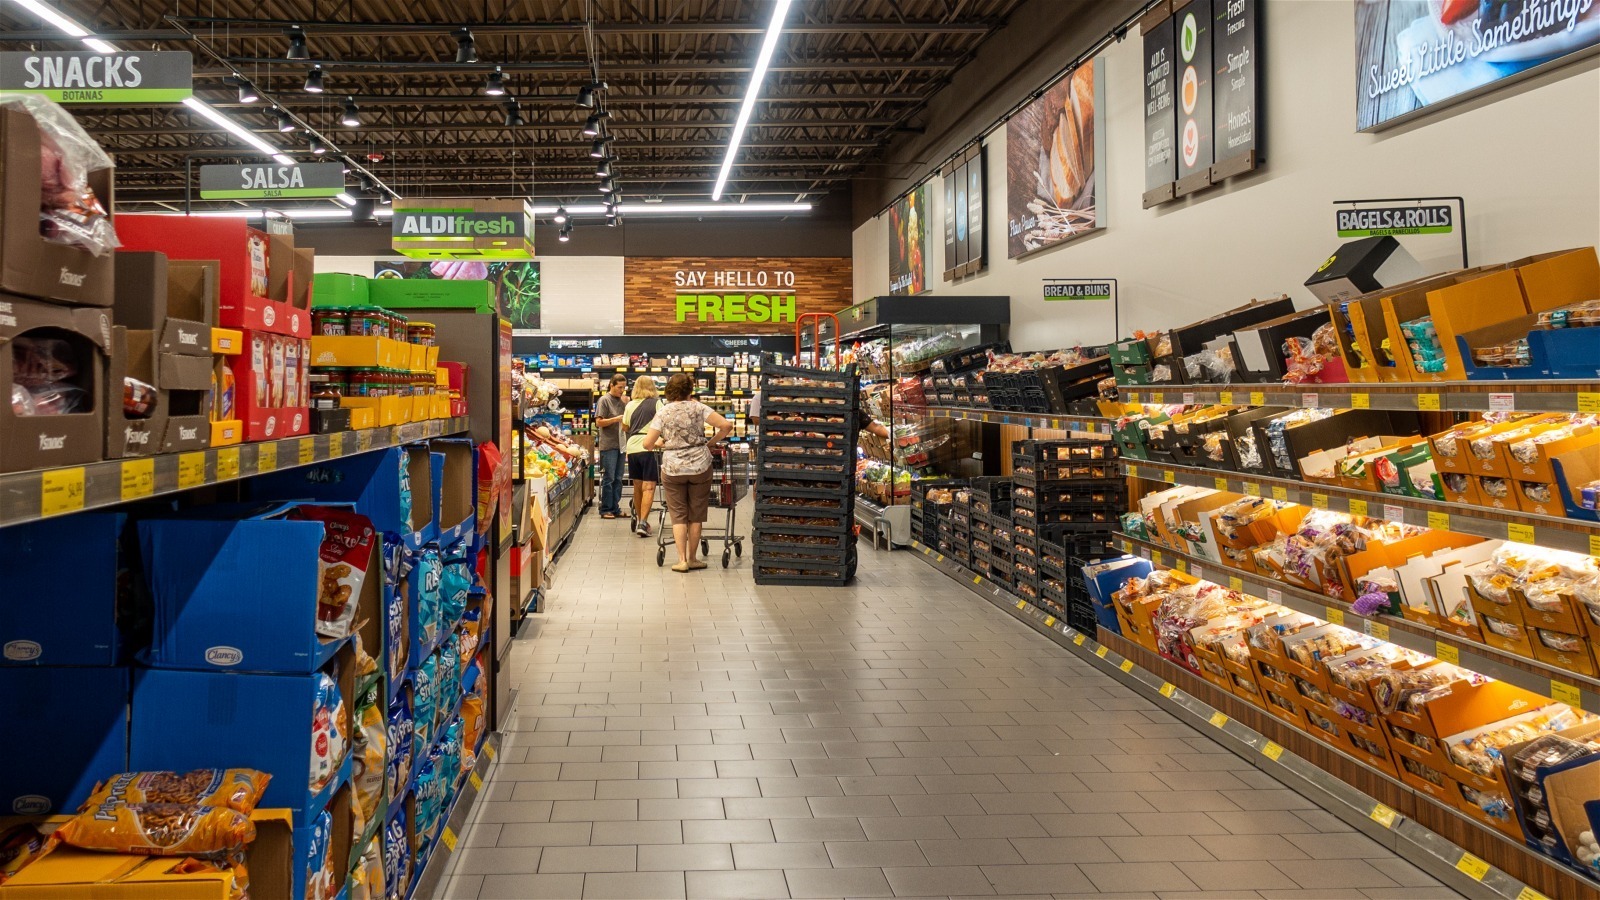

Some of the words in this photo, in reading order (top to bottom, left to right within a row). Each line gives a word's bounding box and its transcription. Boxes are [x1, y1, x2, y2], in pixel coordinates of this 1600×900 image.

[1227, 0, 1246, 20] Fresh
[1227, 18, 1246, 36] Frescura
[1150, 49, 1161, 69] ALDI
[1160, 47, 1166, 62] IS
[1227, 46, 1250, 74] Simple
[1369, 55, 1415, 99] Sweet
[1417, 30, 1468, 78] Little
[1469, 0, 1594, 58] Somethings
[24, 55, 143, 89] SNACKS
[1146, 60, 1170, 87] COMMITTED
[1230, 73, 1247, 92] Simple
[62, 90, 104, 101] BOTANAS
[1150, 84, 1156, 100] TO
[1155, 78, 1167, 97] YOUR
[1146, 92, 1171, 117] WELL-BEING
[1227, 105, 1252, 132] Honest
[241, 166, 305, 190] SALSA
[263, 189, 282, 198] SALSA
[675, 270, 707, 287] SAY
[714, 270, 768, 287] HELLO
[774, 271, 795, 287] TO
[1044, 286, 1075, 297] BREAD
[1076, 286, 1084, 296] &
[1084, 284, 1110, 296] BUNS
[676, 293, 796, 323] FRESH
[207, 649, 242, 663] Clancy's
